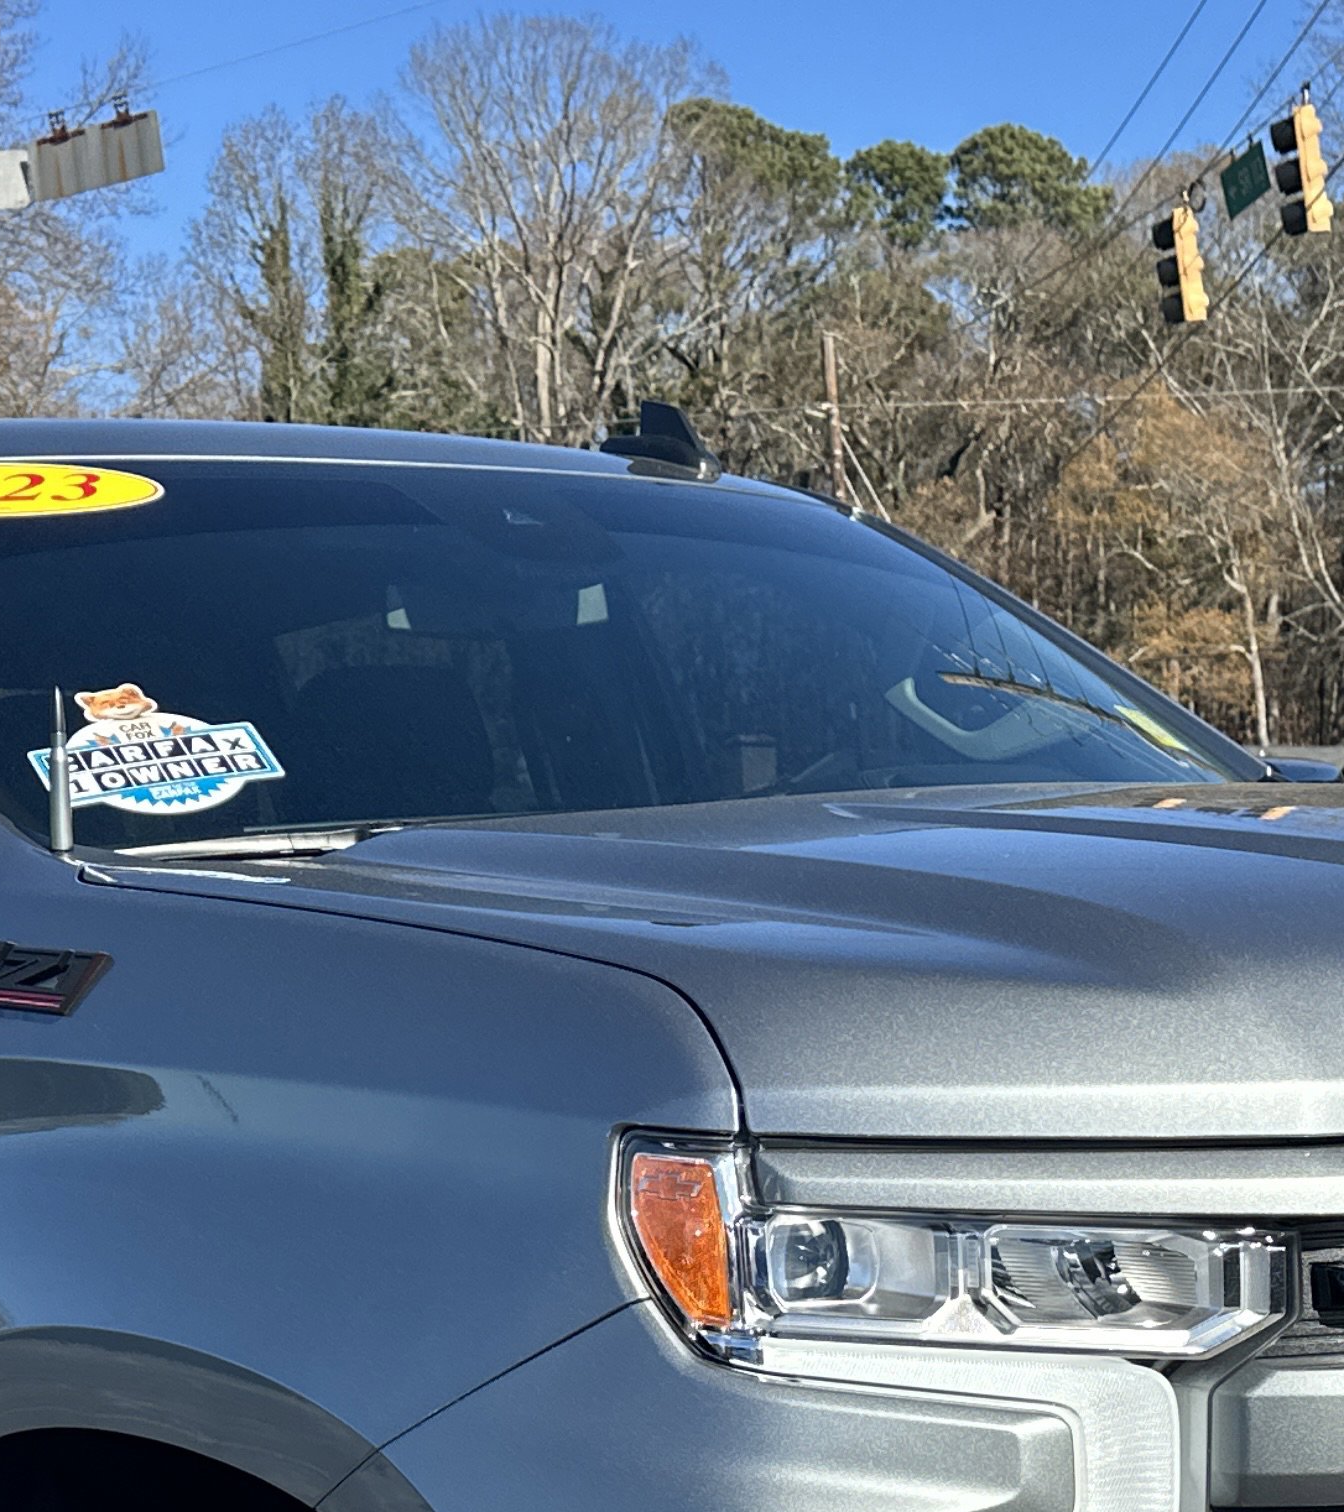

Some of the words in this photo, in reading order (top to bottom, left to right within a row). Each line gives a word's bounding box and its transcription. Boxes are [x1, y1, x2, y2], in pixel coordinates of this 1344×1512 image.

[118, 722, 152, 733] CAR
[125, 730, 156, 741] FOX
[100, 753, 261, 791] OWNER
